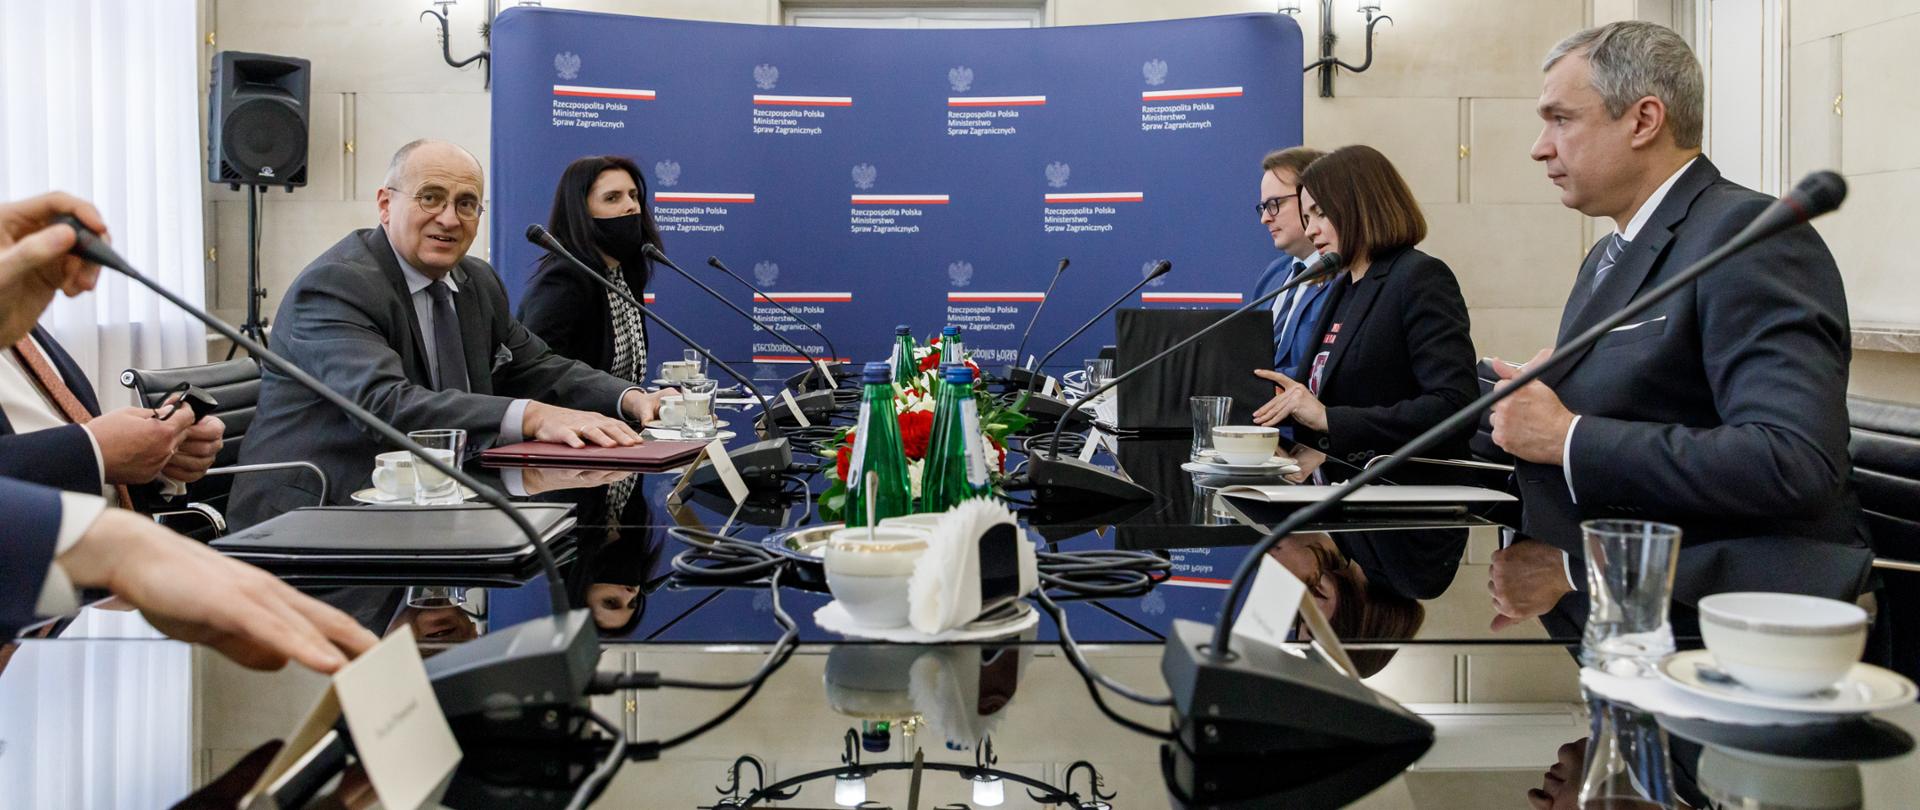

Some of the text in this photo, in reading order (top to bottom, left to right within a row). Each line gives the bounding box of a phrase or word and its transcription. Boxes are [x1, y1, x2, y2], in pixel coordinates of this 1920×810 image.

[553, 99, 628, 111] Rzeczpospolita Polska
[1142, 102, 1215, 113] Rzeczpospolita Polska
[553, 109, 599, 118] Ministerstwo
[753, 109, 825, 118] Rzeczpospolita Polska
[948, 110, 1019, 119] Rzeczpospolita Polska
[553, 118, 625, 129] Spraw Zagranicznych
[753, 117, 797, 126] Ministerstwo
[1142, 120, 1212, 131] Spraw Zagranicznych
[753, 126, 822, 135] Spraw Zagranicznych
[948, 127, 1016, 136] Spraw Zagranicznych
[654, 206, 728, 215] Rzeczpospolita Polska
[851, 208, 922, 217] Rzeczpospolita Polska
[1044, 206, 1116, 215] Rzeczpospolita Polska
[654, 215, 699, 223] Ministerstwo
[851, 216, 895, 224] Ministerstwo
[676, 224, 724, 233] Zagranicznych
[851, 225, 919, 234] Spraw Zagranicznych
[1044, 223, 1113, 233] Spraw Zagranicznych
[947, 306, 996, 314] Rzeczpospolita
[968, 322, 1015, 331] Zagranicznych
